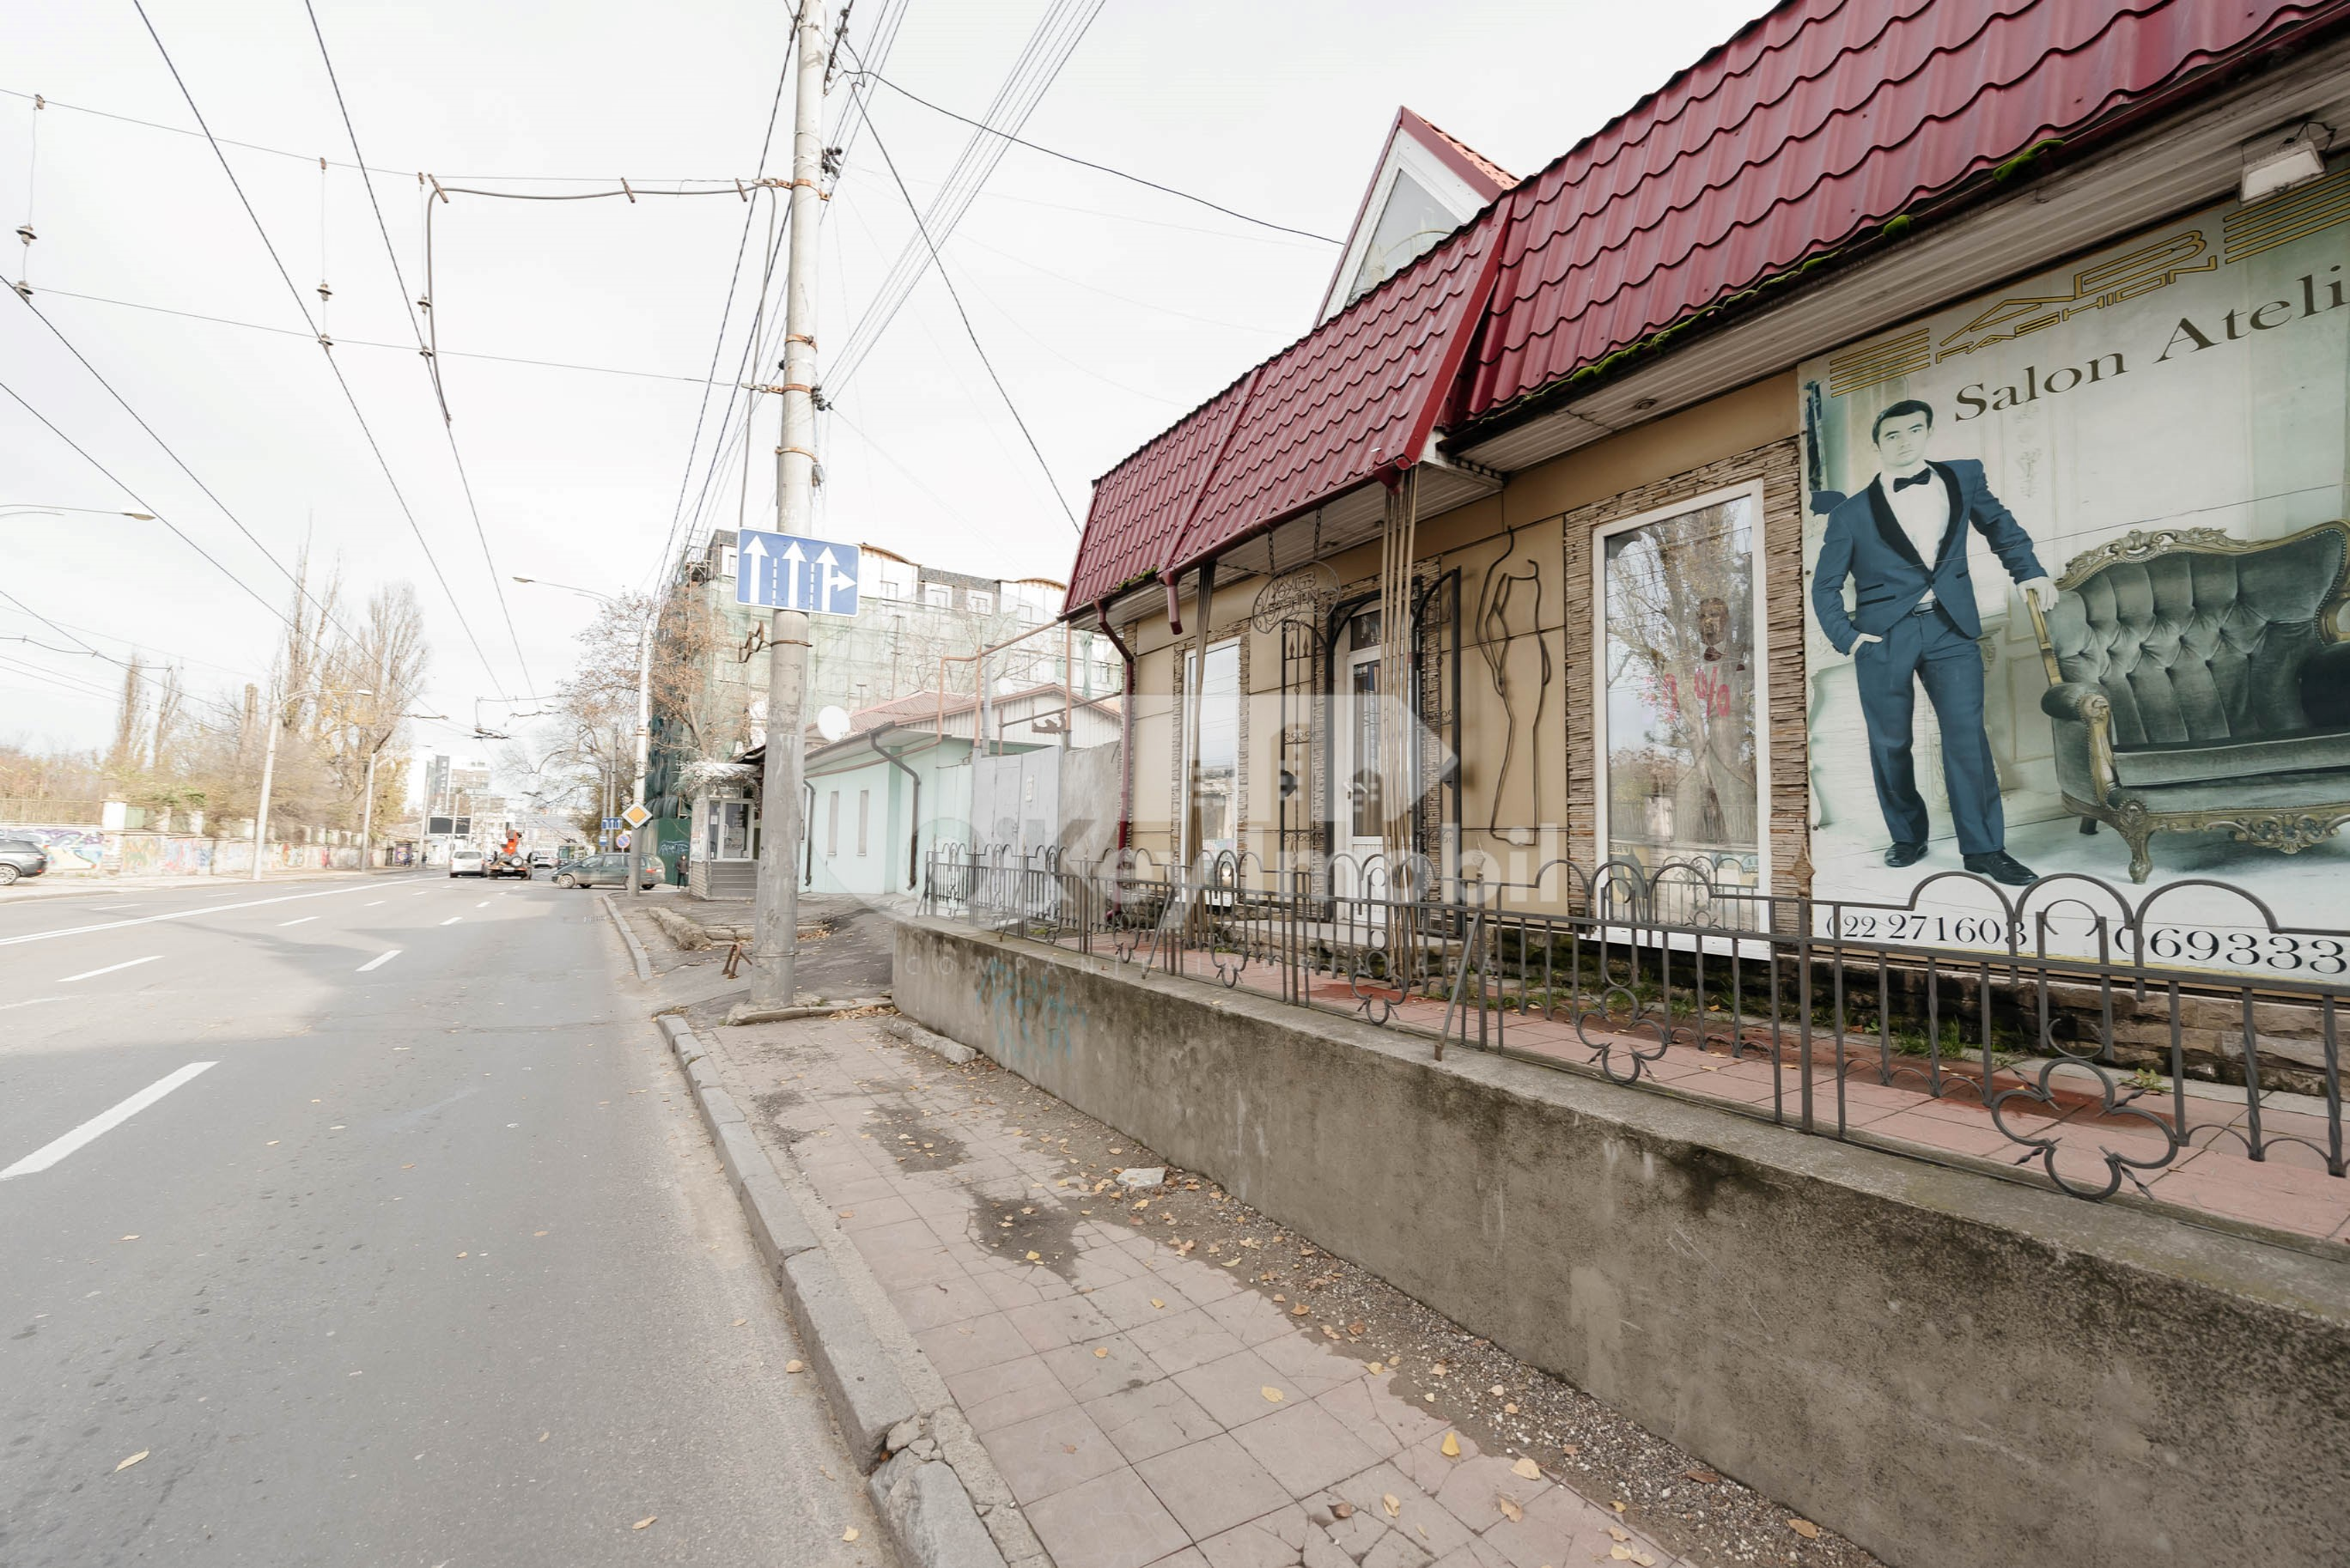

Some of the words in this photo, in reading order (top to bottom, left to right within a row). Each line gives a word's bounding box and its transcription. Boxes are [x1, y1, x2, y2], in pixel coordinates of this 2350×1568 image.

[1935, 255, 2218, 364] FASHION
[1955, 351, 2130, 422] Salon
[2152, 264, 2350, 365] Ateli
